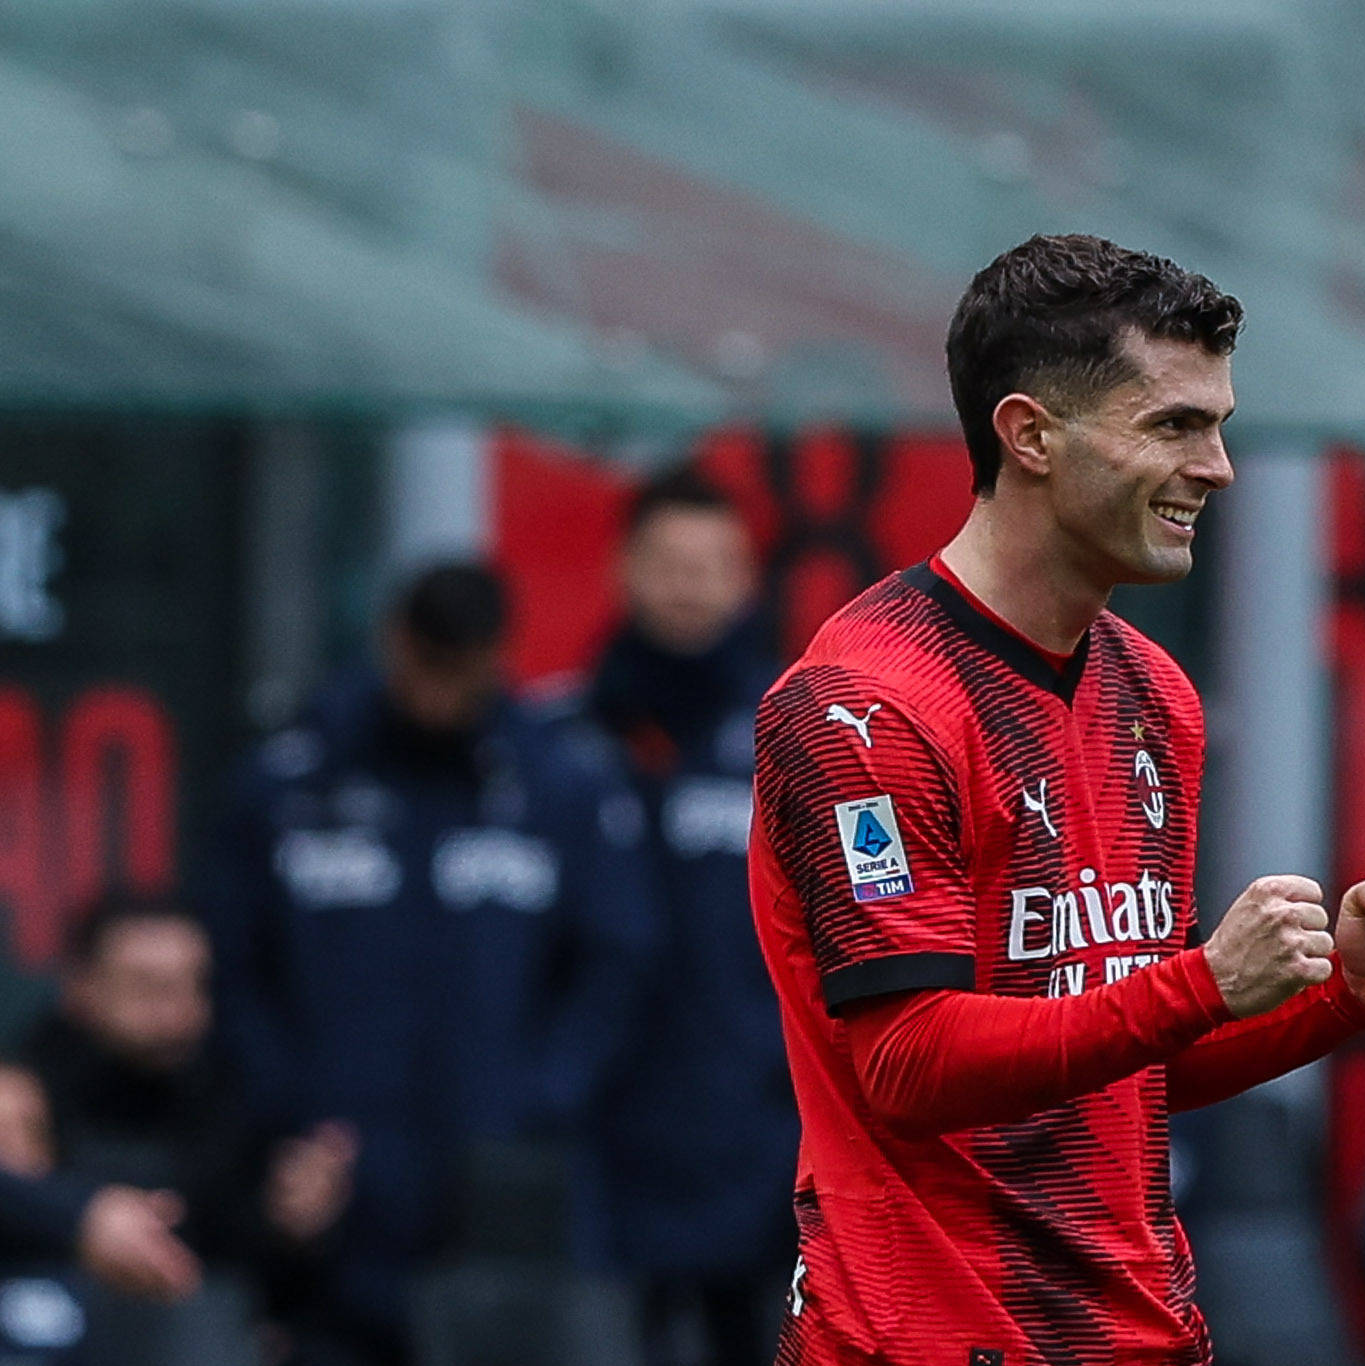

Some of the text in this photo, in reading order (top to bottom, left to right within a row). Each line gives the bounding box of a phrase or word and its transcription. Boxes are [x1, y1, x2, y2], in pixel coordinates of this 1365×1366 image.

[856, 857, 899, 874] SERIE A
[876, 880, 905, 895] TIM
